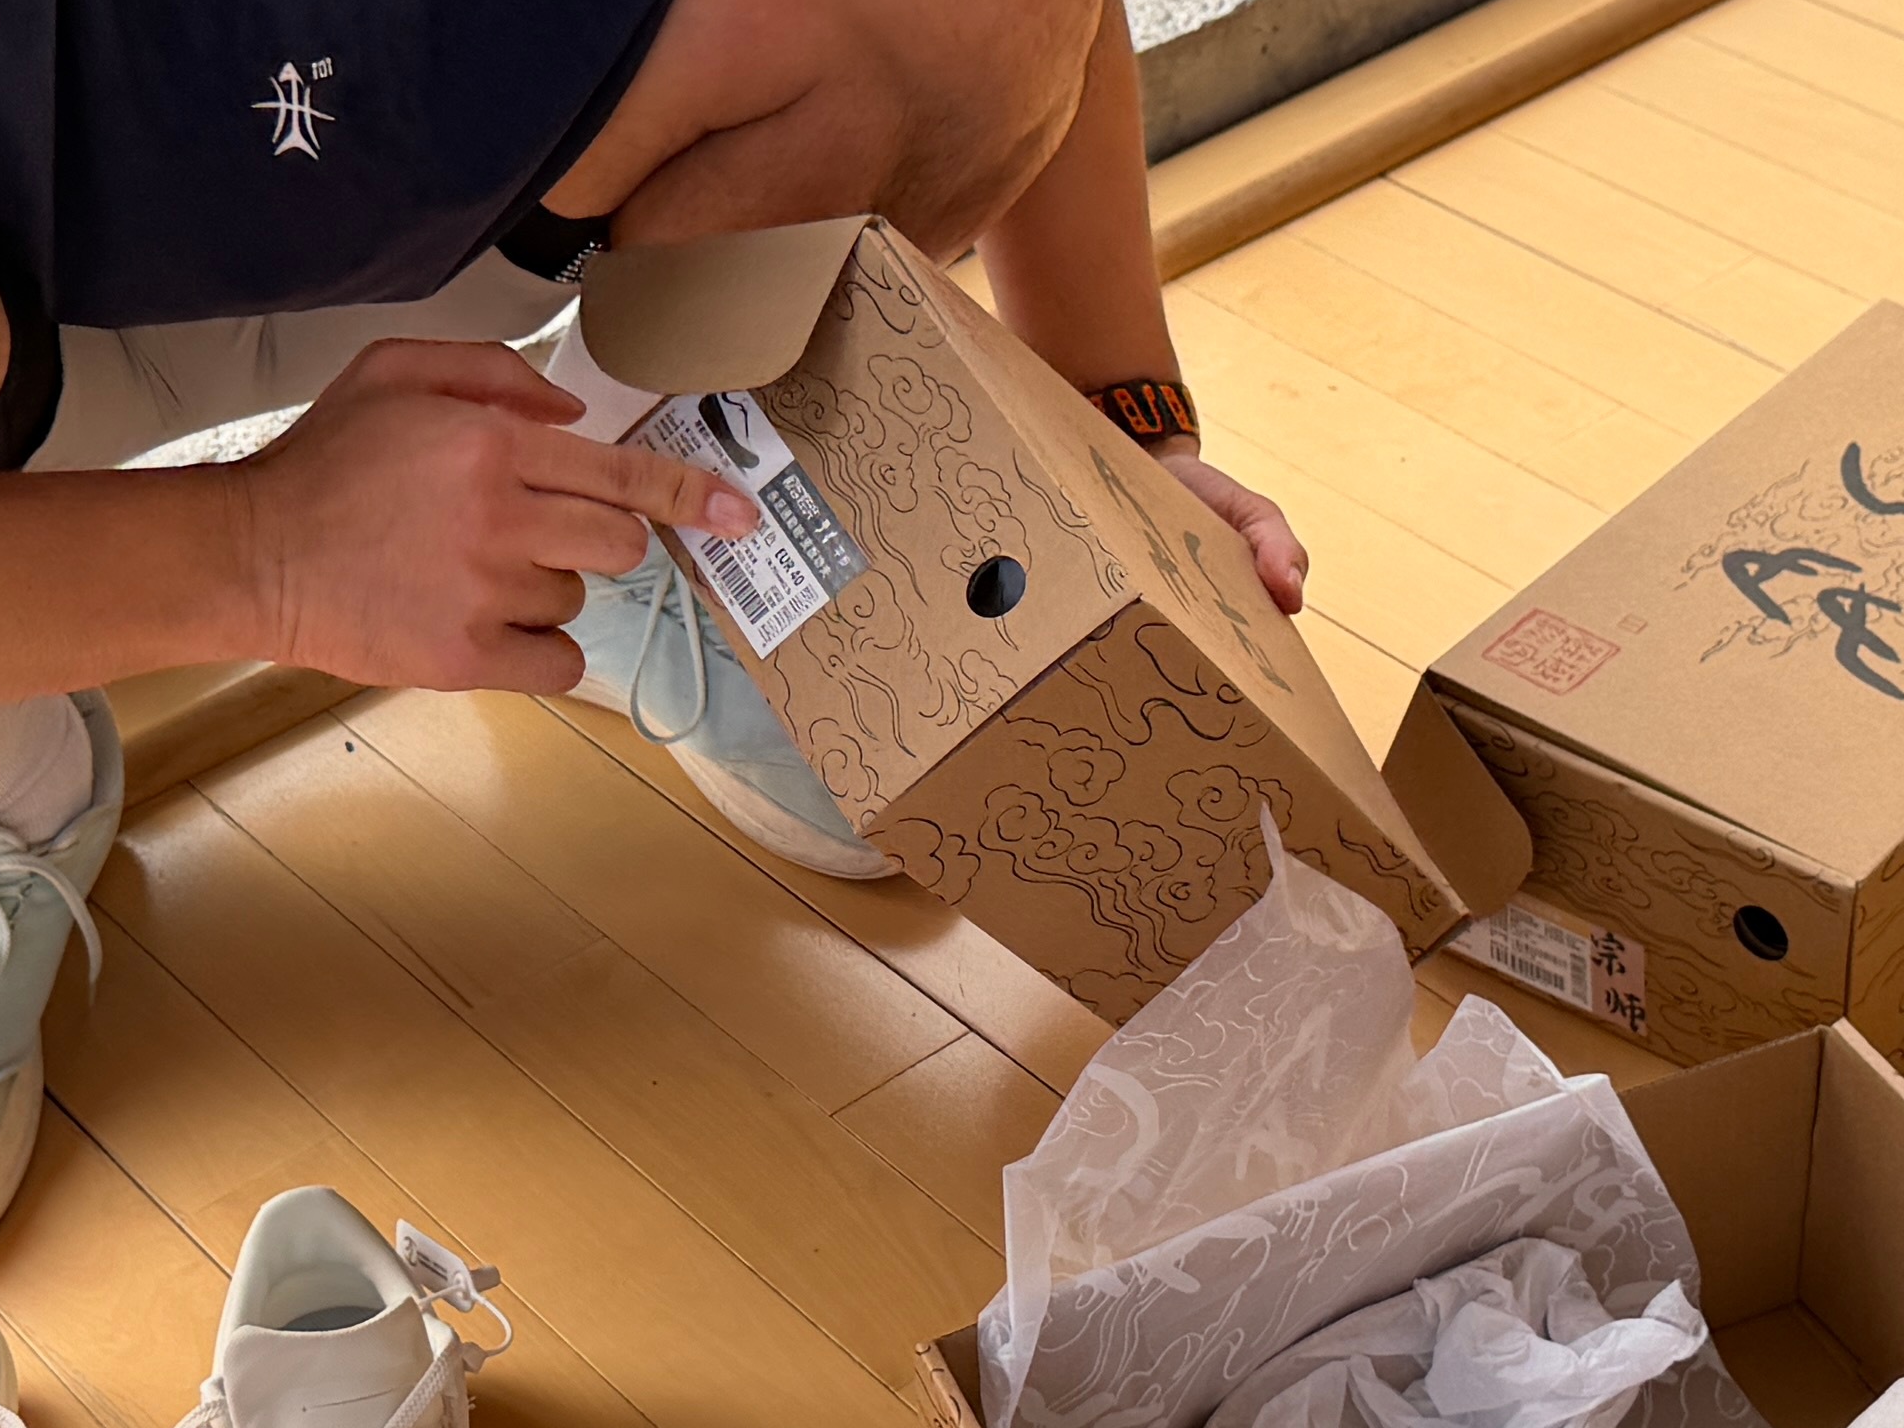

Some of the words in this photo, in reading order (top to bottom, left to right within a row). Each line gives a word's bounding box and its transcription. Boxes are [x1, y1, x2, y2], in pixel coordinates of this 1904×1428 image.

[774, 548, 796, 574] EUR
[791, 570, 805, 586] 40
[1590, 932, 1646, 1034] 宗师
